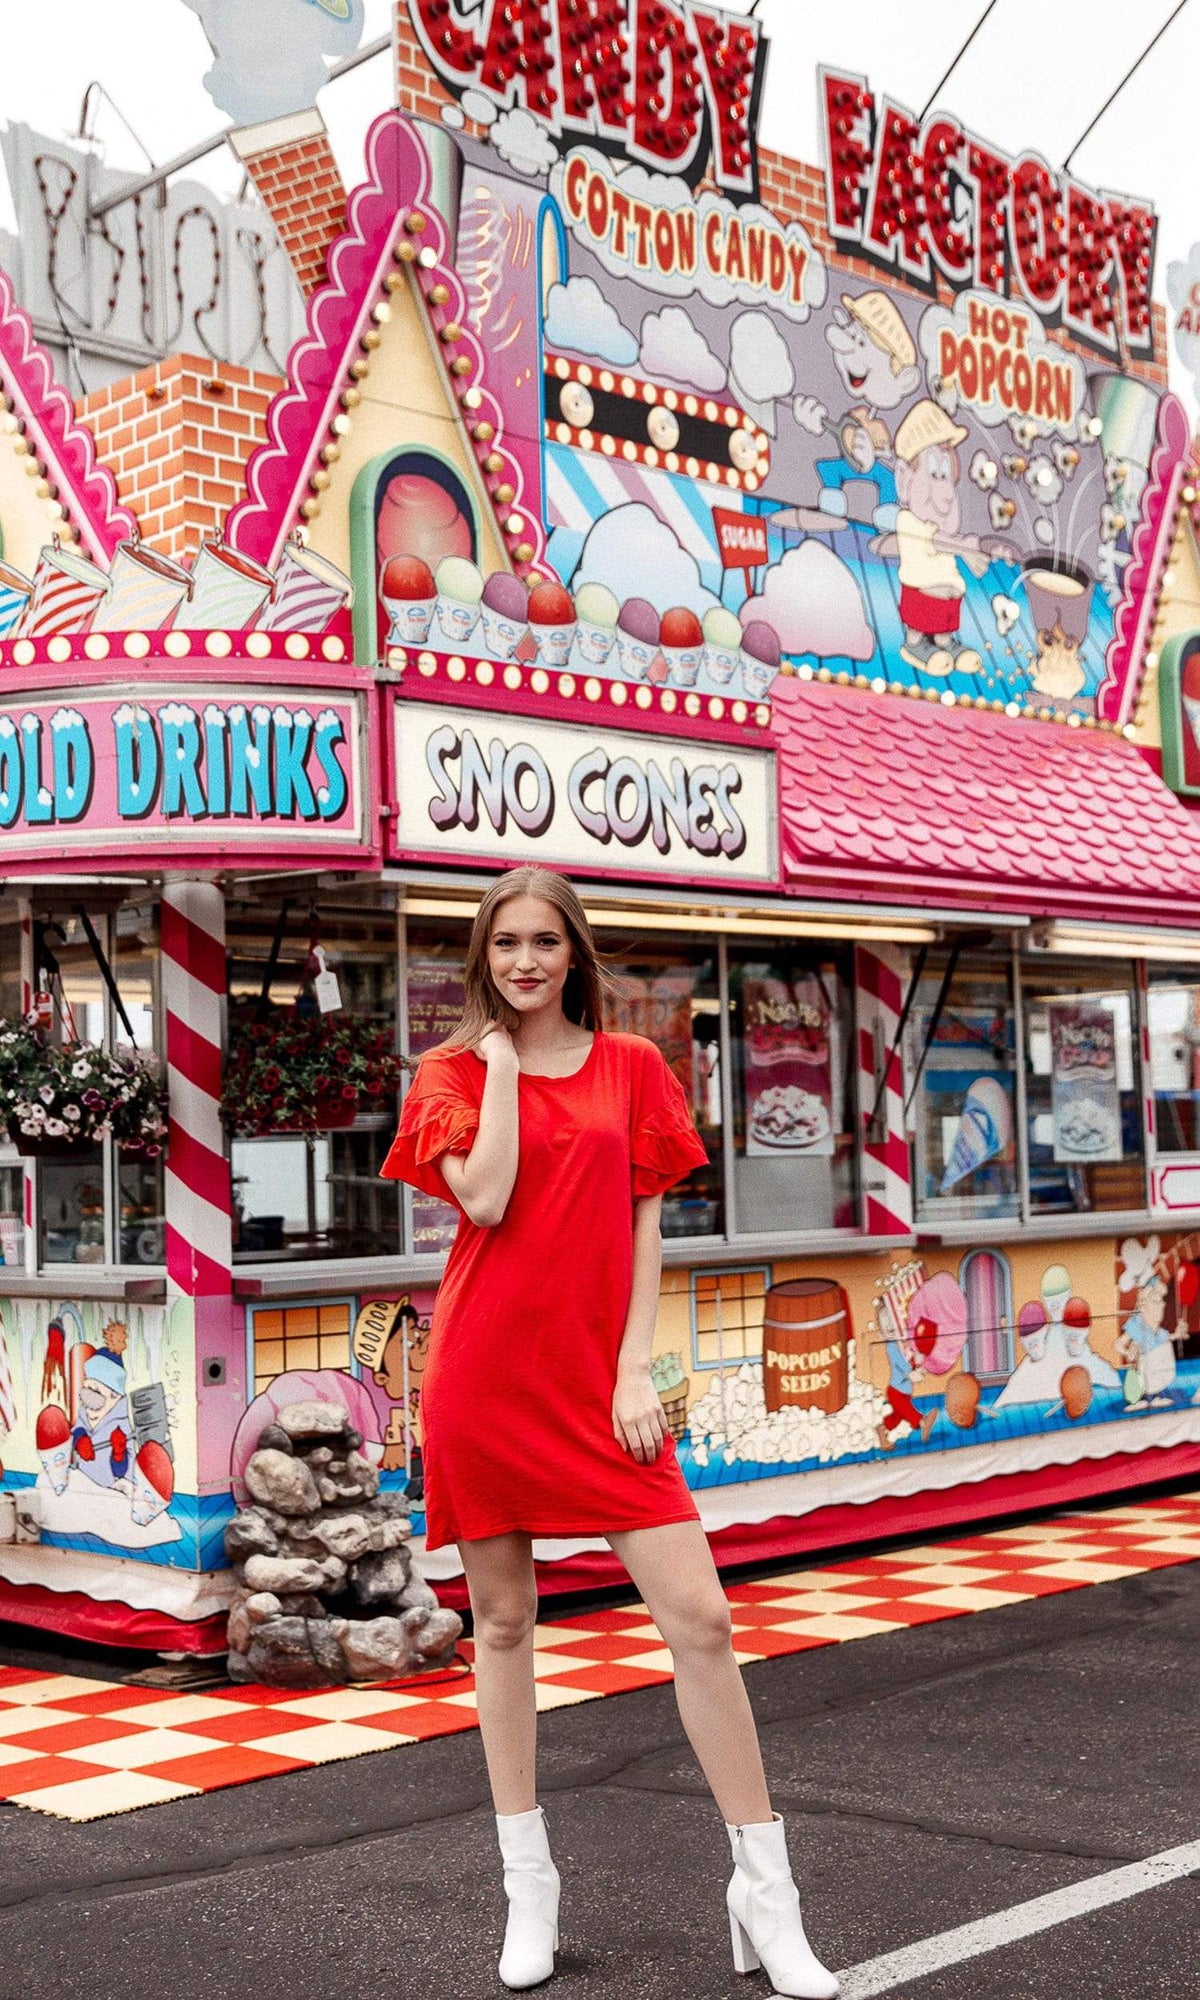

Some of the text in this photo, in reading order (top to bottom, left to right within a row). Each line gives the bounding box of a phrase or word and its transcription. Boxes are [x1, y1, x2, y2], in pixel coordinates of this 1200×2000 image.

[565, 156, 808, 304] COTTON CANDY
[816, 64, 1156, 350] FACTORY
[968, 300, 1029, 350] HOT
[940, 330, 1074, 424] POPCORN
[720, 523, 767, 552] SUGAR
[112, 701, 348, 824] DRINKS
[425, 724, 748, 860] SNO CONES
[766, 1341, 842, 1372] POPCORN
[780, 1369, 831, 1394] SEEDS
